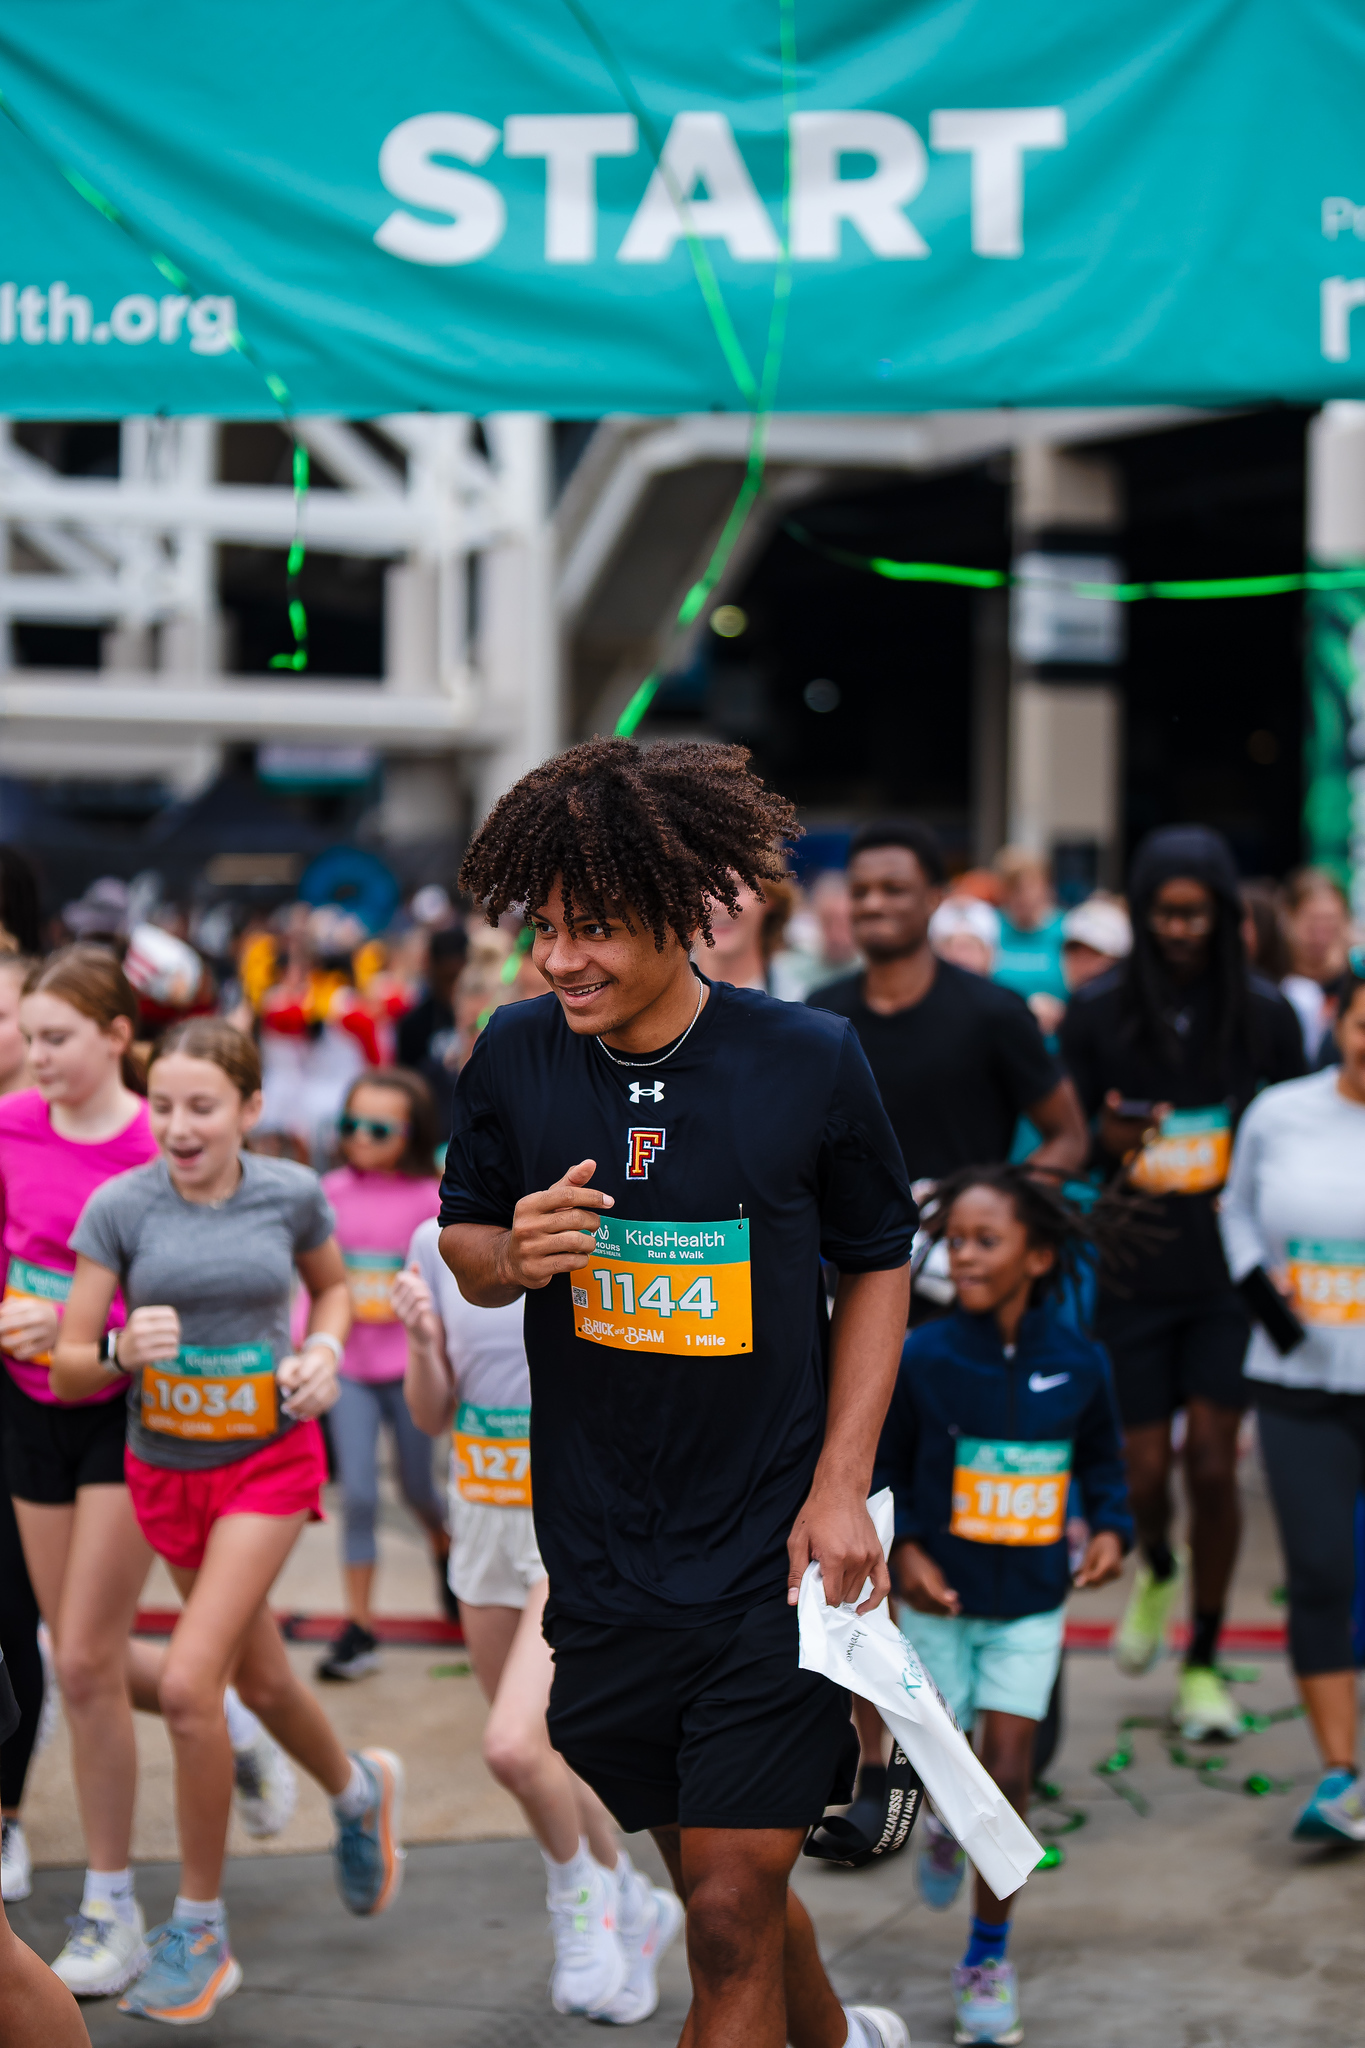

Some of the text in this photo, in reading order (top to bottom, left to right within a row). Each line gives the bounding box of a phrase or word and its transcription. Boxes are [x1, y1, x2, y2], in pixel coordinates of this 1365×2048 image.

[371, 106, 1067, 267] START
[0, 280, 237, 356] lth.org
[626, 1128, 665, 1180] F
[625, 1229, 725, 1248] KidsHealth
[647, 1250, 704, 1259] Run & Walk
[592, 1268, 719, 1320] 1144
[581, 1317, 665, 1345] BRICK and BEAM
[685, 1334, 726, 1346] 1 Mile
[154, 1378, 259, 1417] 1034
[466, 1444, 530, 1481] 127
[974, 1480, 1060, 1520] 1165
[871, 1788, 904, 1855] ESSENTIALS
